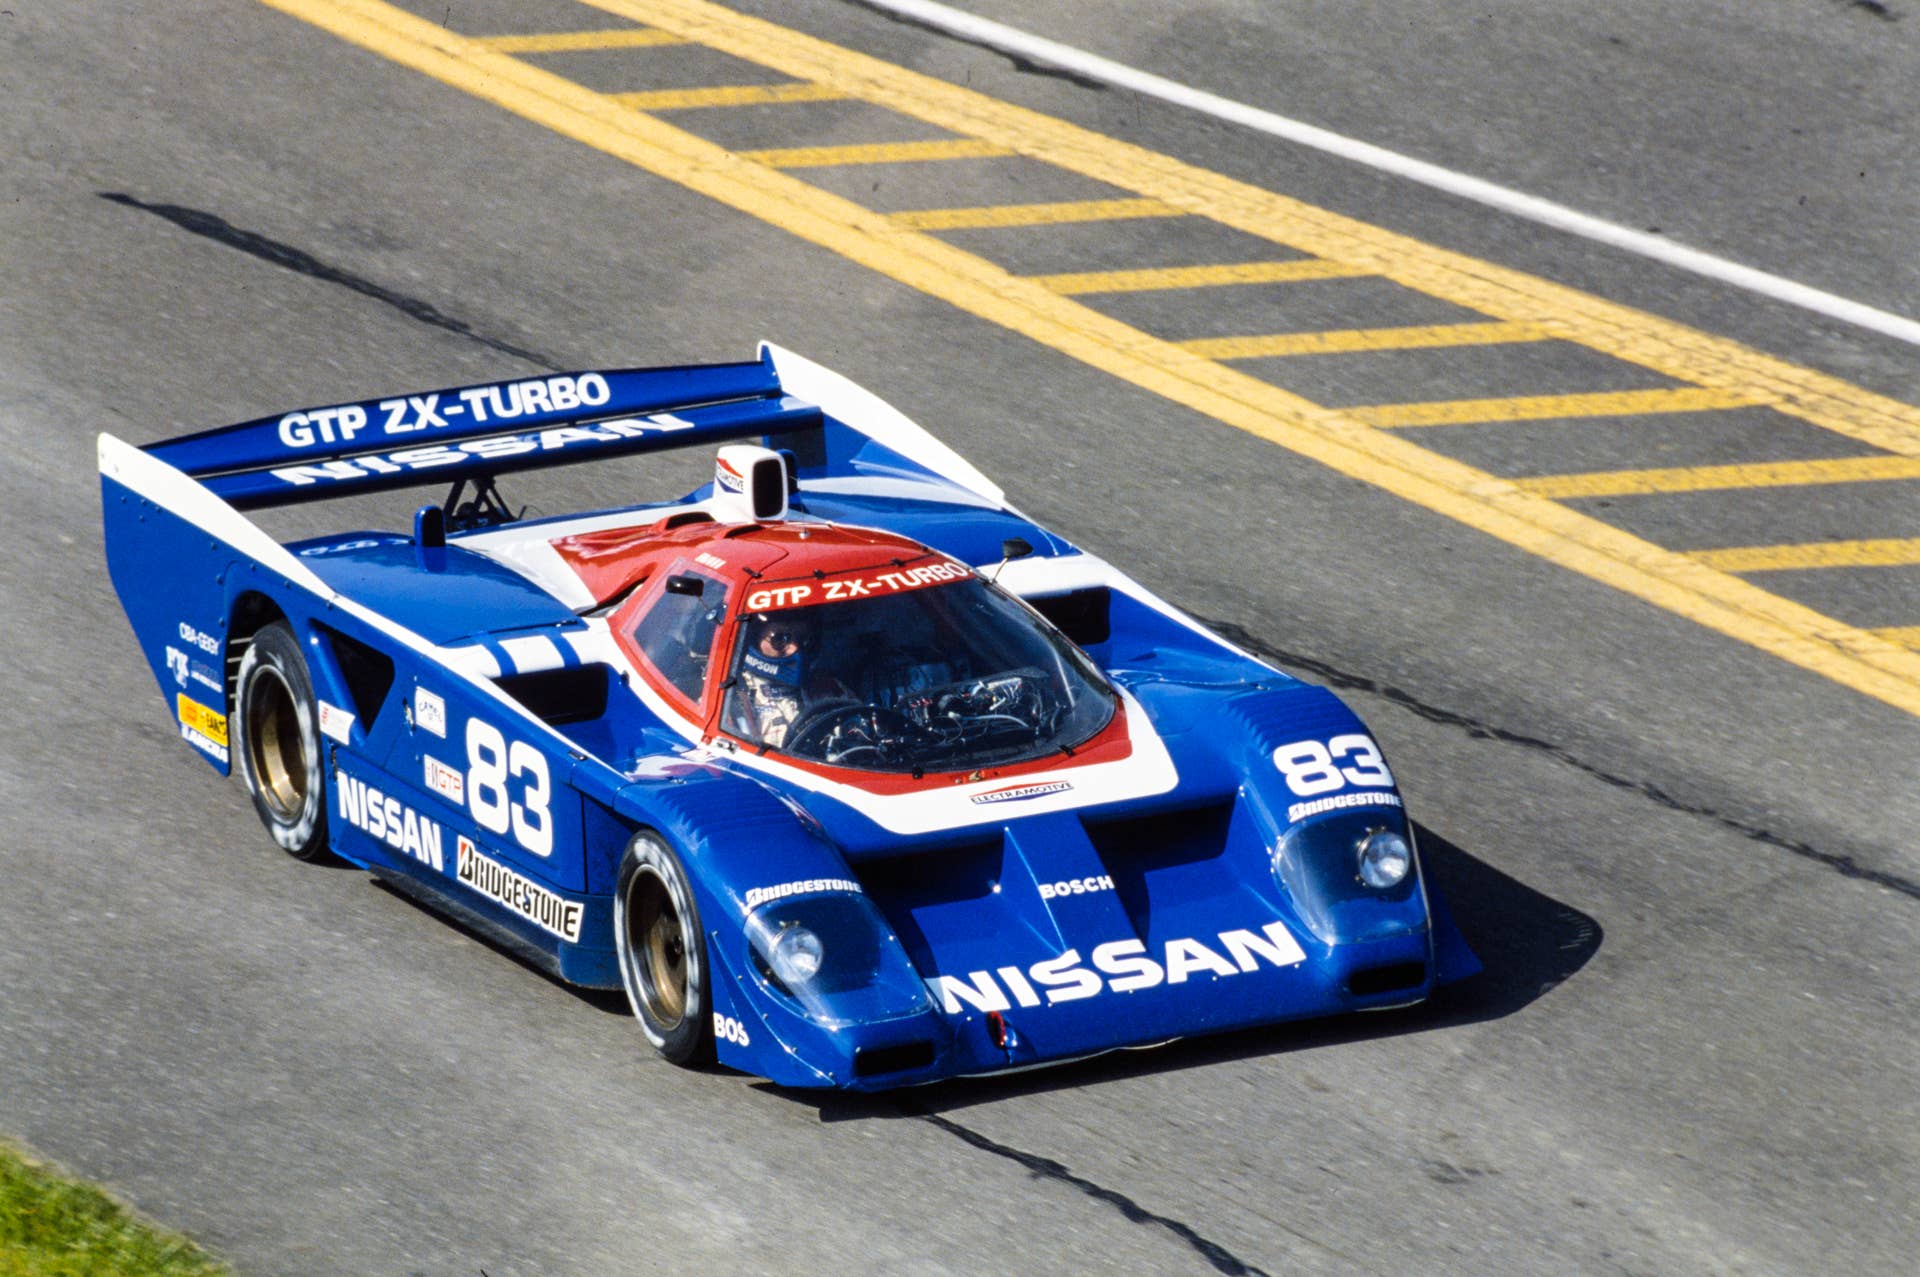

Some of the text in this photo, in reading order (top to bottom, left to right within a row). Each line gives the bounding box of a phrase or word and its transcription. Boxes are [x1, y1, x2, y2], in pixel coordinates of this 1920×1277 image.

[279, 372, 611, 448] GTP ZX-TURBO
[270, 413, 695, 486] NISSAN
[747, 561, 969, 610] GTP ZX-TURBO
[466, 717, 552, 857] 83
[970, 782, 1073, 804] ELECTRAMOTIVE
[1272, 734, 1395, 796] 83
[337, 771, 443, 872] NISSAN
[1288, 792, 1402, 823] BRIDGESTONE
[457, 841, 580, 938] BRIDGESTONE
[746, 879, 862, 909] BRIDGESTONE
[1039, 875, 1114, 899] BOSCH
[928, 921, 1306, 1014] NISSAN
